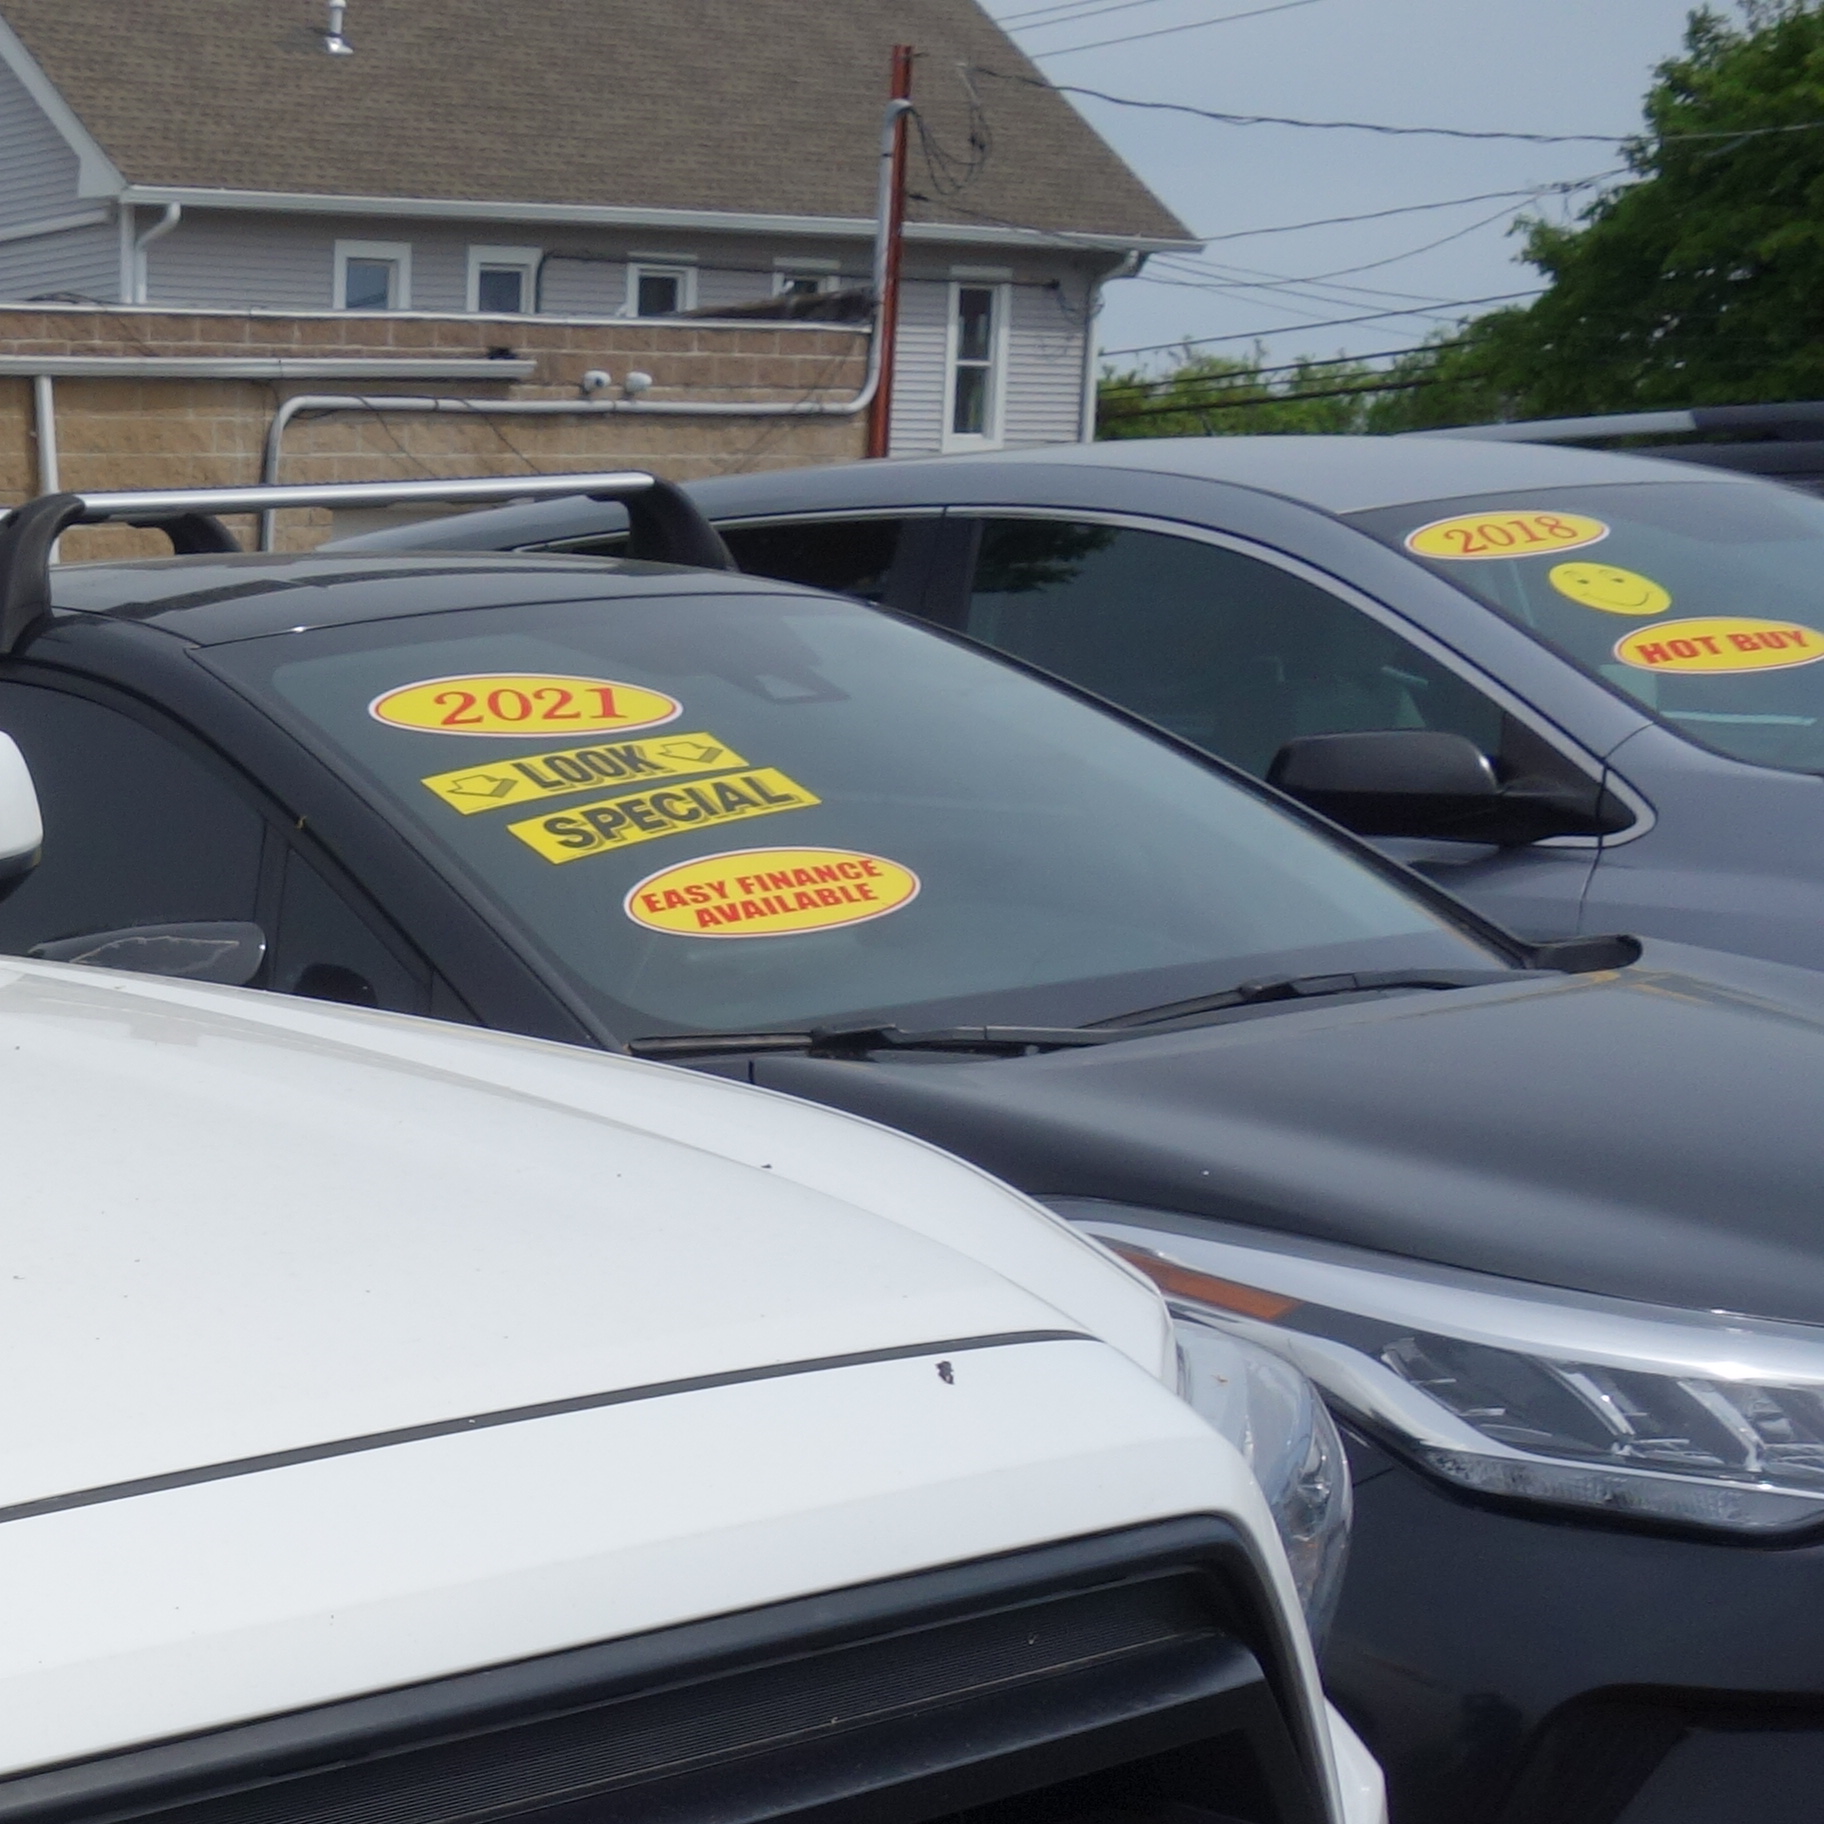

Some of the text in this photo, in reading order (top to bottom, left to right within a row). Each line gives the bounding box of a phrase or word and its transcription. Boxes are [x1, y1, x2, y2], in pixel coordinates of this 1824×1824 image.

[1443, 515, 1579, 555] 2018
[1634, 629, 1811, 665] HOT BUY
[433, 687, 629, 726] 2021
[510, 744, 674, 791] LOOK
[542, 776, 800, 851] SPECIAL
[640, 858, 884, 914] EASY FINANCE
[693, 882, 881, 929] AVAILABLE
